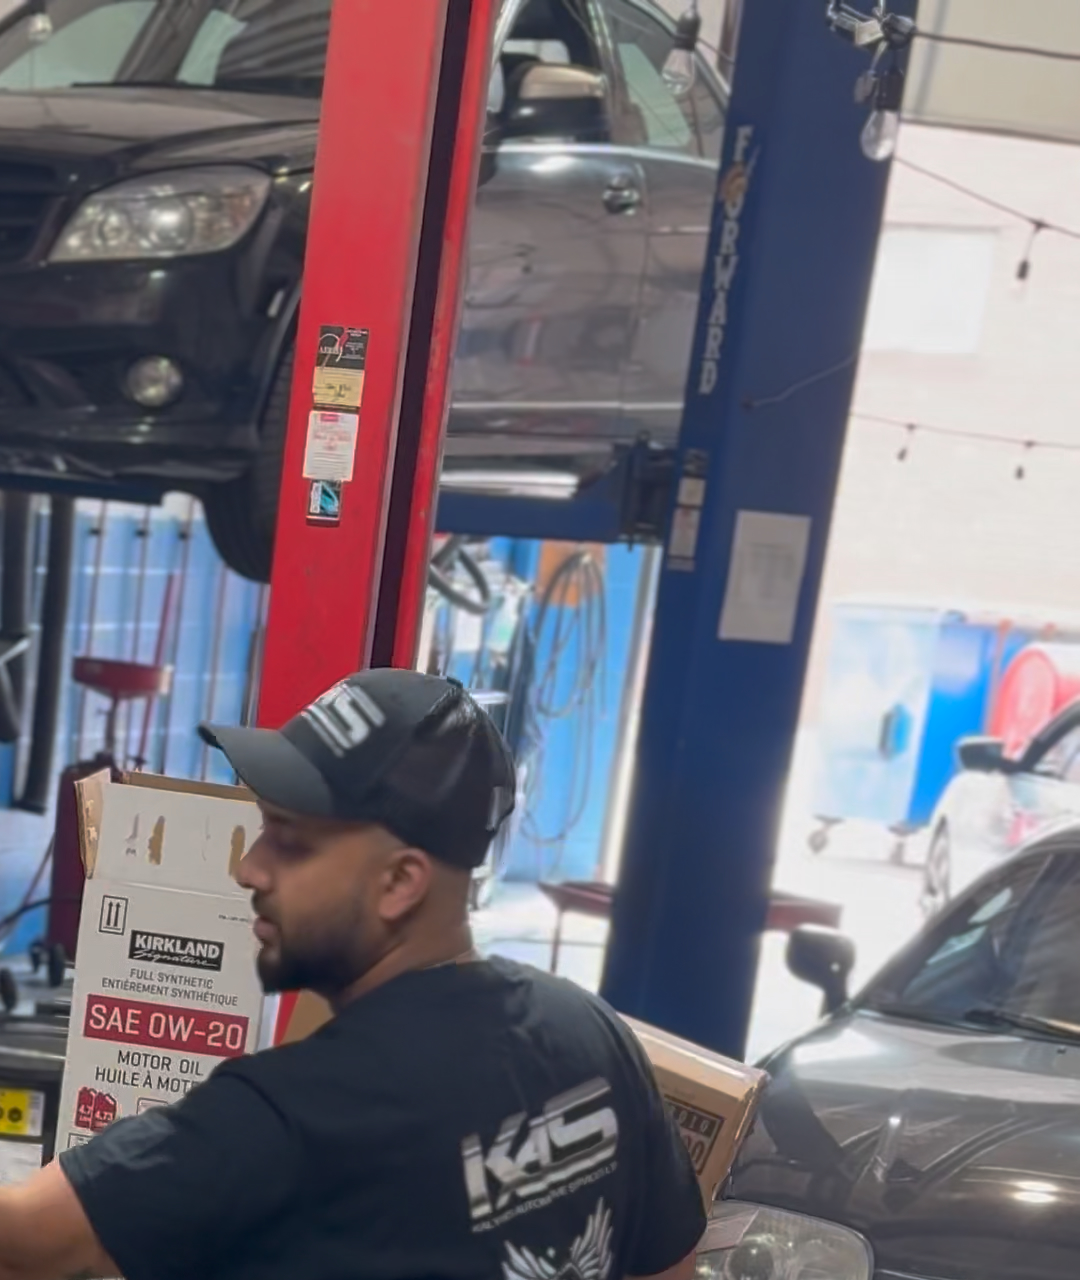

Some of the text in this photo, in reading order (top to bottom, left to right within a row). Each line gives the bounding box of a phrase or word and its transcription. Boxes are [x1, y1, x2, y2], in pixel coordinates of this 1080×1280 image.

[697, 124, 754, 395] FORWARD
[132, 948, 219, 968] Signature
[135, 934, 221, 959] KIRKLAND
[101, 976, 239, 1007] ENTIÈREMENT SYNTHÉTIQUE
[130, 968, 214, 990] FULL SYNTHETIC
[89, 1003, 143, 1036] SAE
[117, 1050, 204, 1077] MOTOR OIL
[95, 1066, 140, 1088] HUILE
[143, 1069, 154, 1090] À
